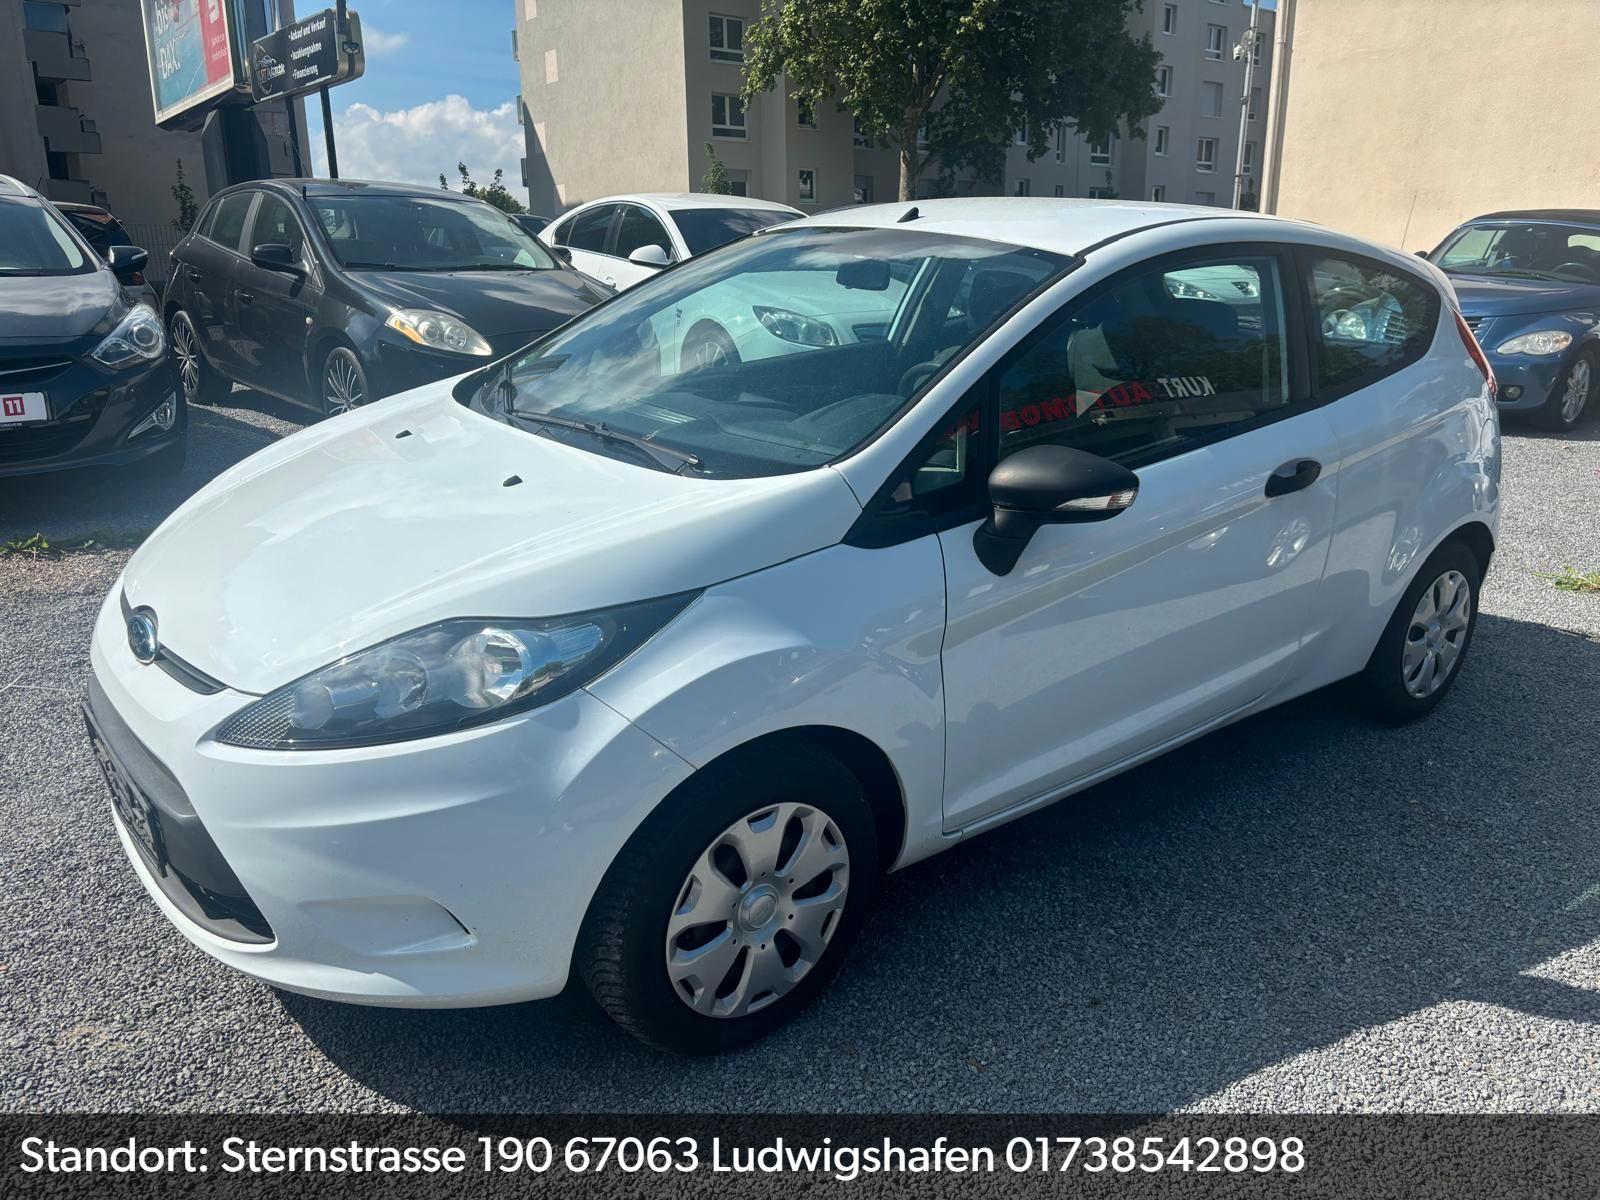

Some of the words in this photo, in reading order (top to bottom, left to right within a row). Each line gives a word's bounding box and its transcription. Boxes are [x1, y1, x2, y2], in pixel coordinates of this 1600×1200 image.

[303, 24, 311, 36] und
[311, 16, 326, 33] Verkauf
[160, 39, 181, 80] DAX.
[294, 64, 319, 80] Finanzierung
